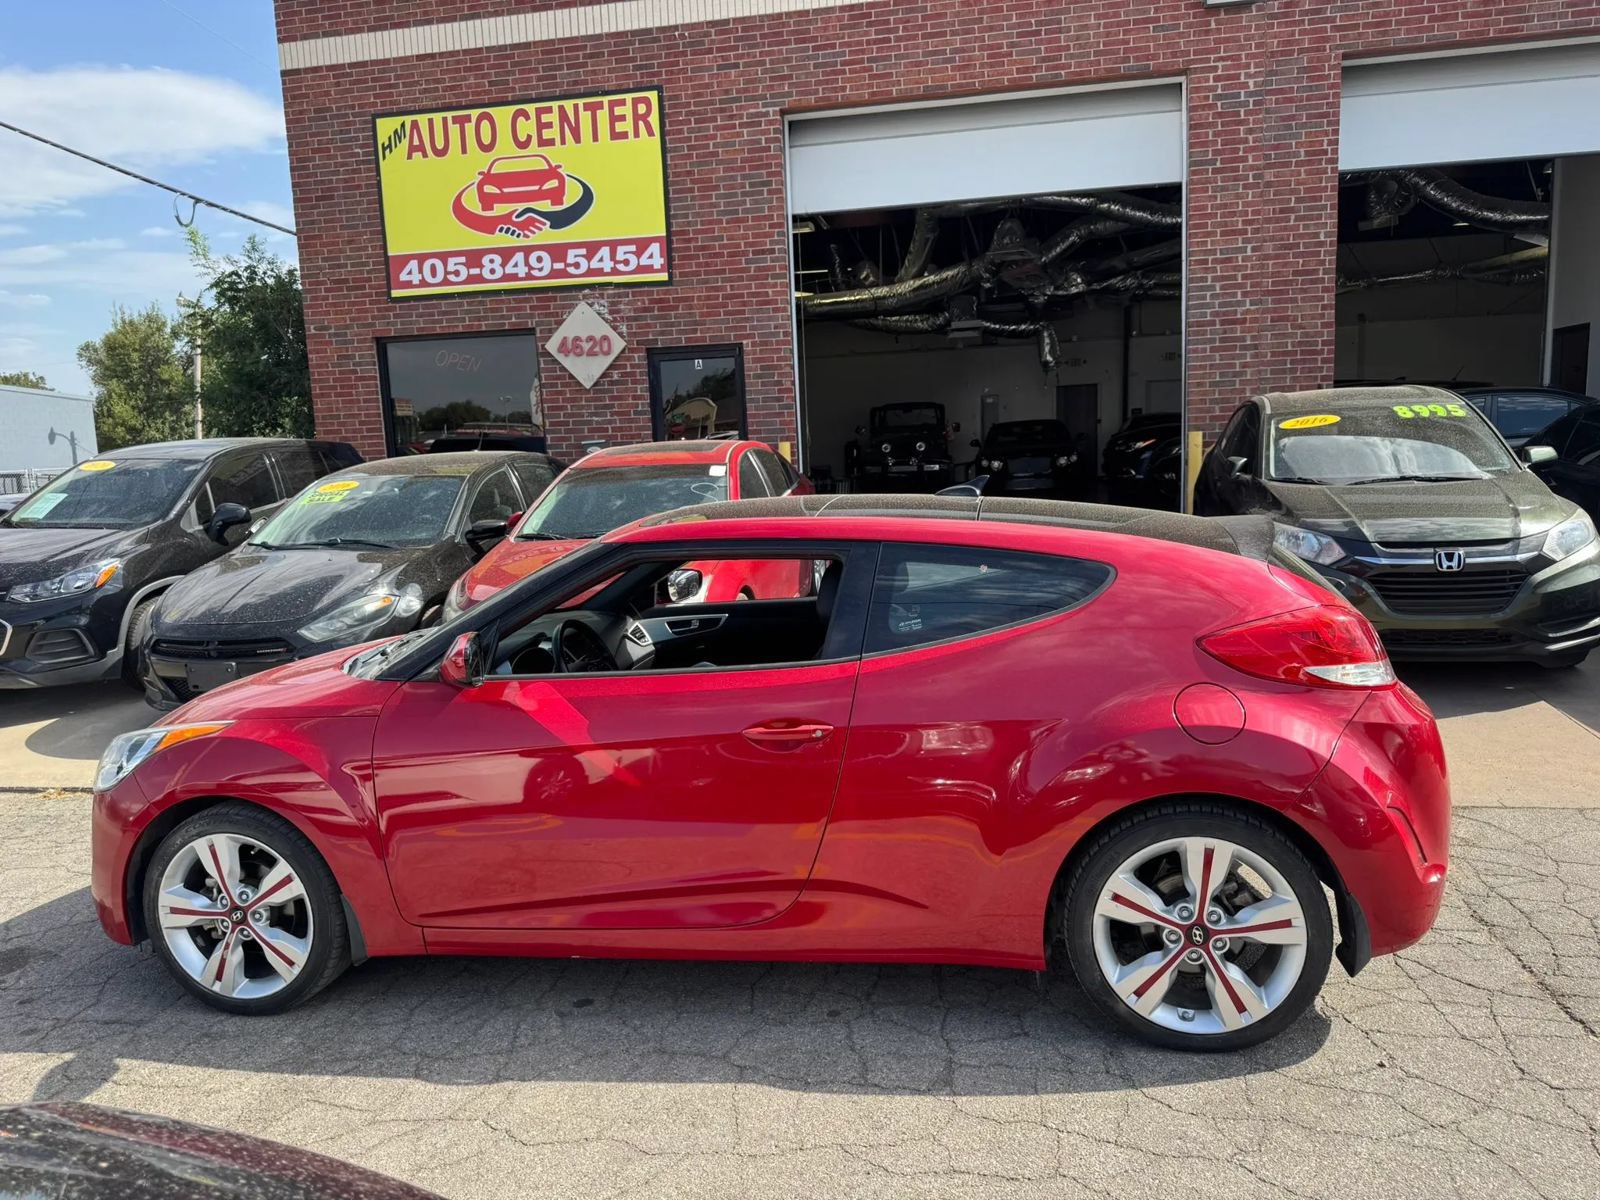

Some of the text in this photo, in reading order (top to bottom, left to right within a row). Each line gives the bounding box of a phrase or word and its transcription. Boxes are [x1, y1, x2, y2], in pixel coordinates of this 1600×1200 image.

[381, 95, 656, 161] HM AUTO CENTER
[399, 243, 664, 285] 405-849-5454
[557, 335, 612, 357] 4620
[435, 350, 482, 372] OPEN
[1393, 404, 1467, 418] 8995
[1290, 417, 1329, 428] 2016
